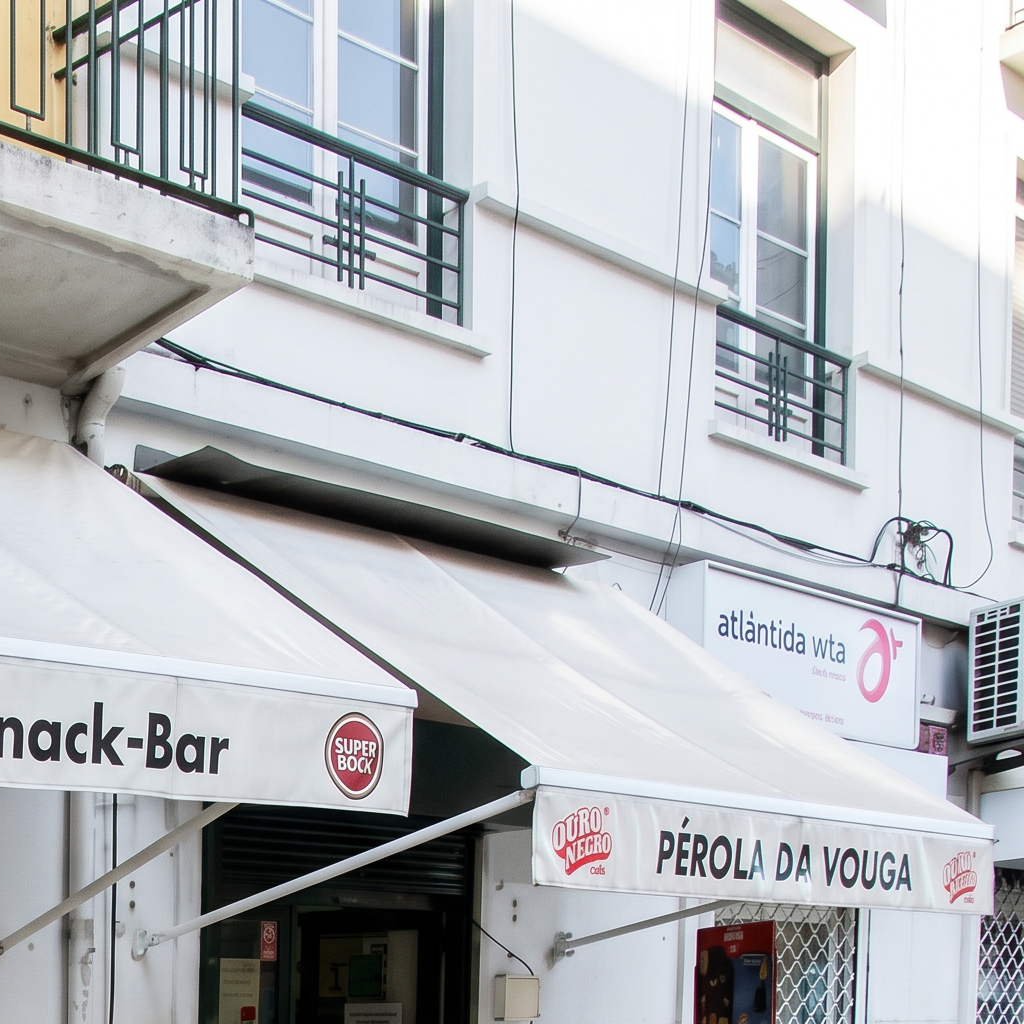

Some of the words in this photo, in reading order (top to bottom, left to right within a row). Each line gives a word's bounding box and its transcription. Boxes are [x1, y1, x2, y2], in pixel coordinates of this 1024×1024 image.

[812, 633, 847, 664] wta
[334, 737, 377, 758] SUPER
[337, 754, 374, 775] BOCK
[552, 807, 603, 851] OURO
[656, 816, 766, 881] PÉROLA
[775, 841, 812, 883] DA
[823, 846, 913, 892] VOUGA
